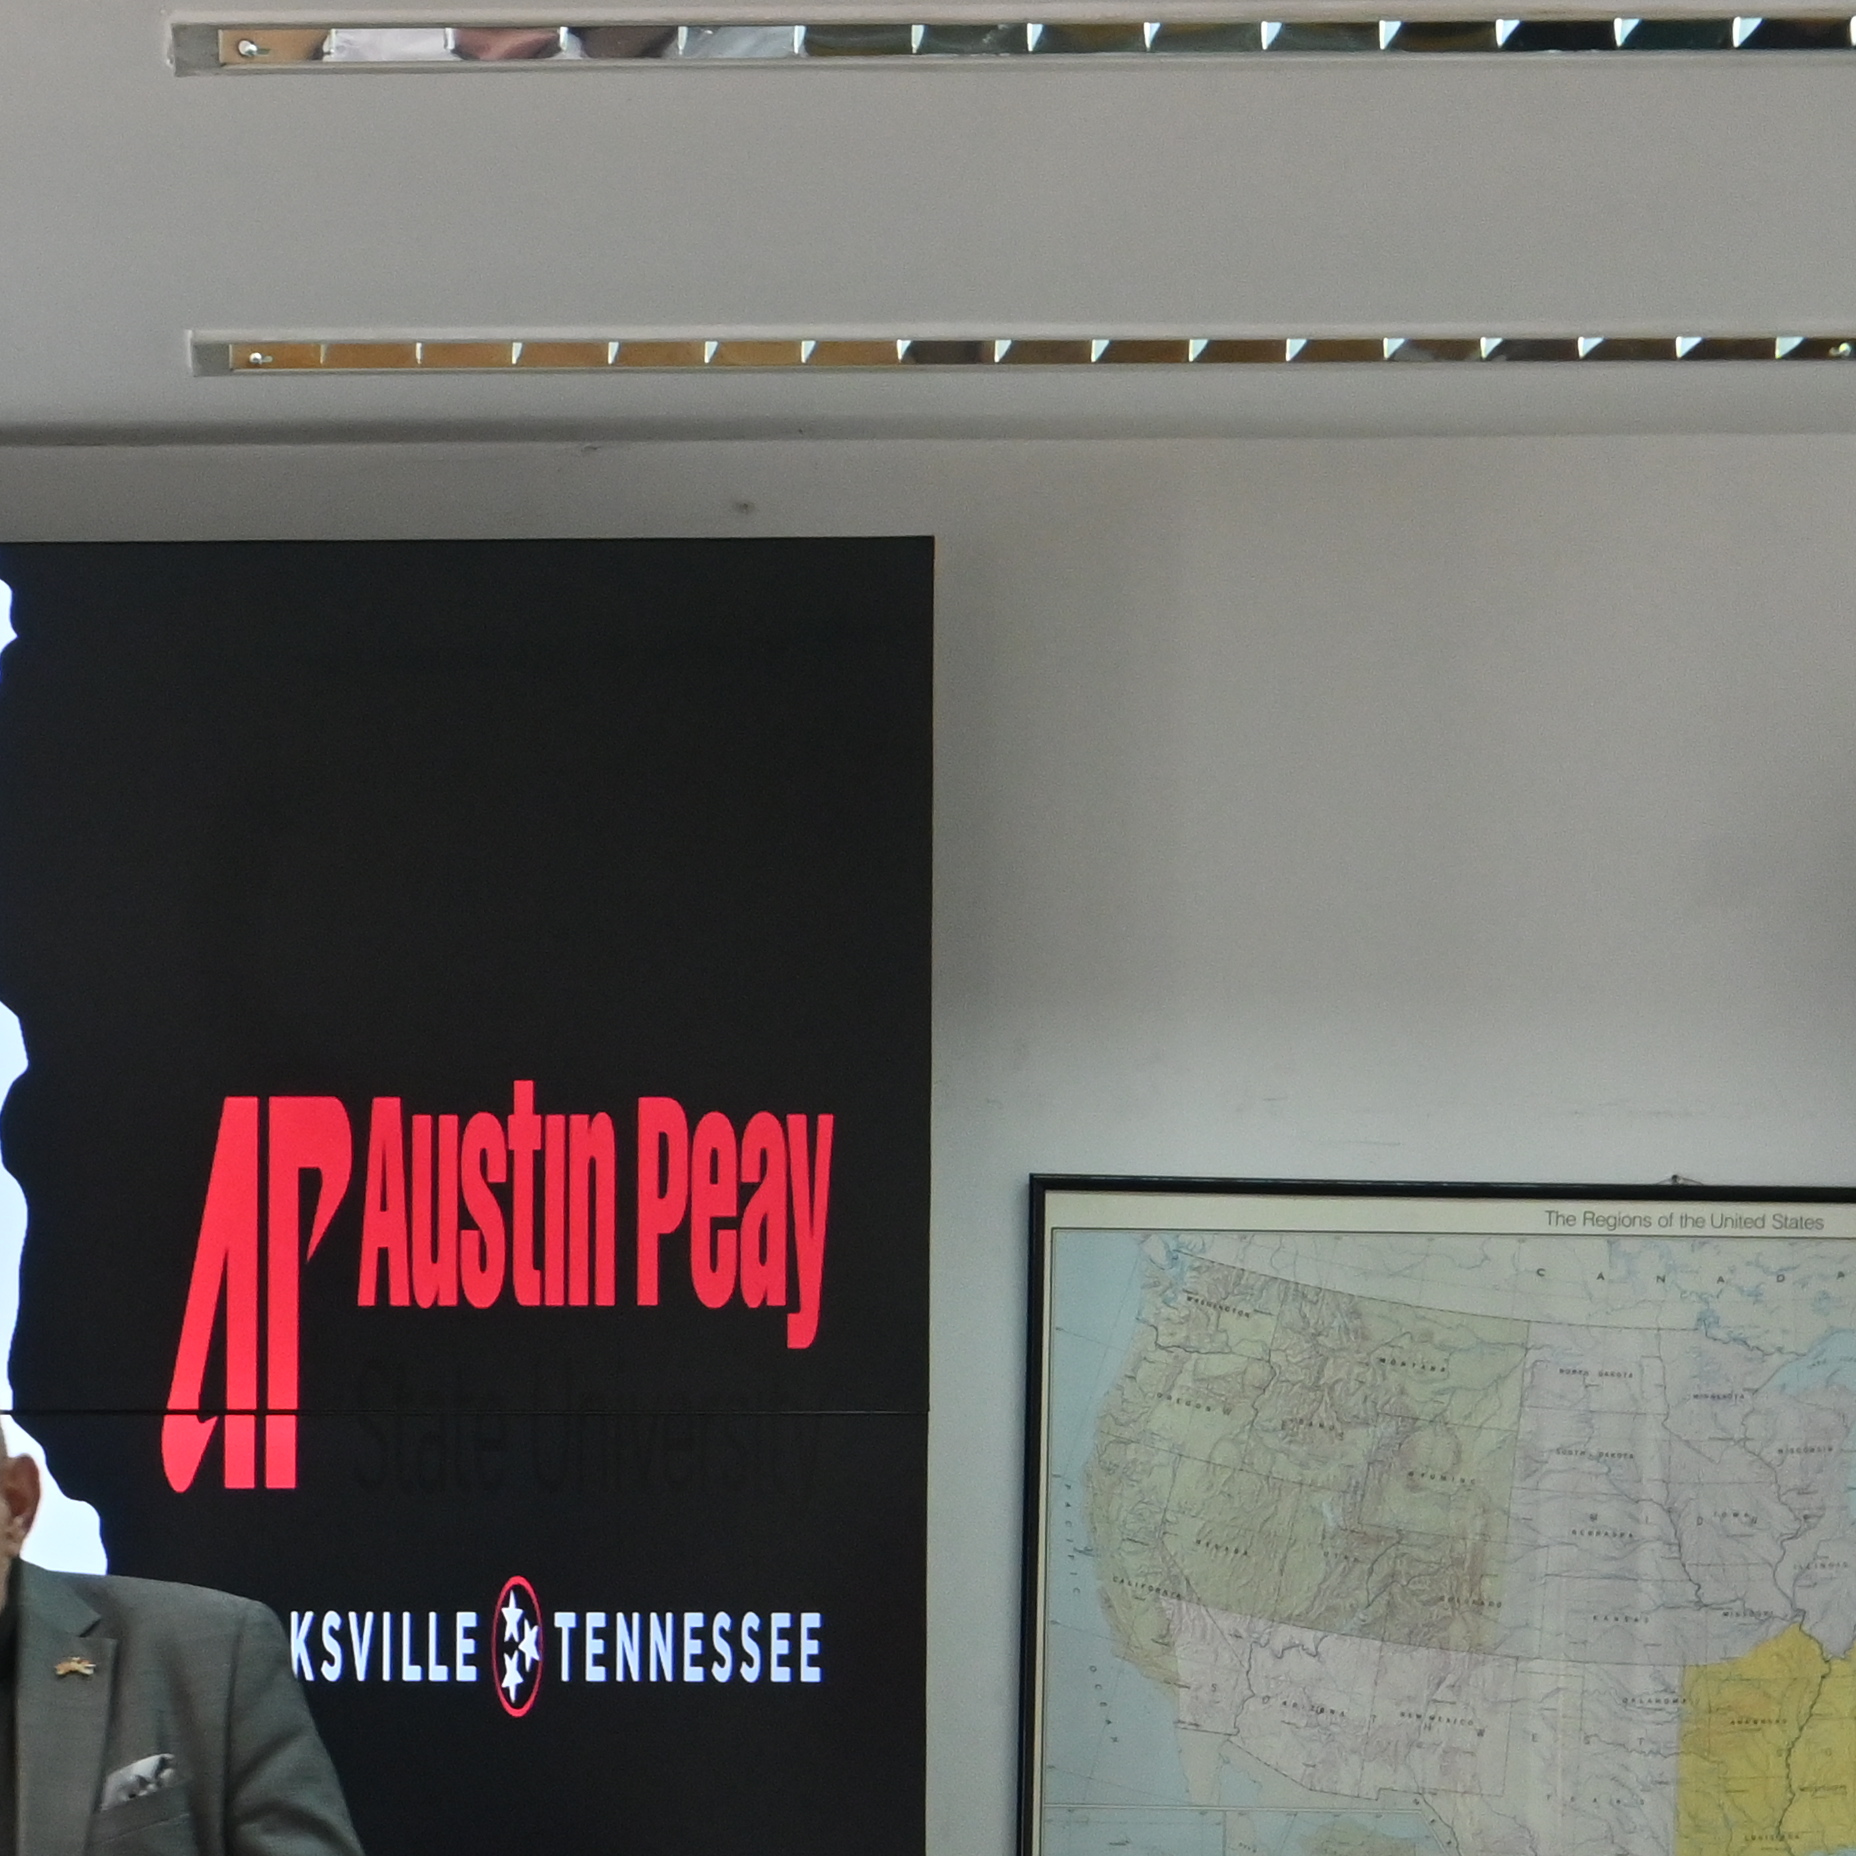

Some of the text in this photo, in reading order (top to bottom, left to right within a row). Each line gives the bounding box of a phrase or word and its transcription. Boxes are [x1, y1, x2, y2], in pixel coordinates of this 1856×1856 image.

[357, 1079, 834, 1349] Austin Peay
[1545, 1210, 1825, 1231] The Regions of the United States
[553, 1611, 821, 1683] TENNESSEE
